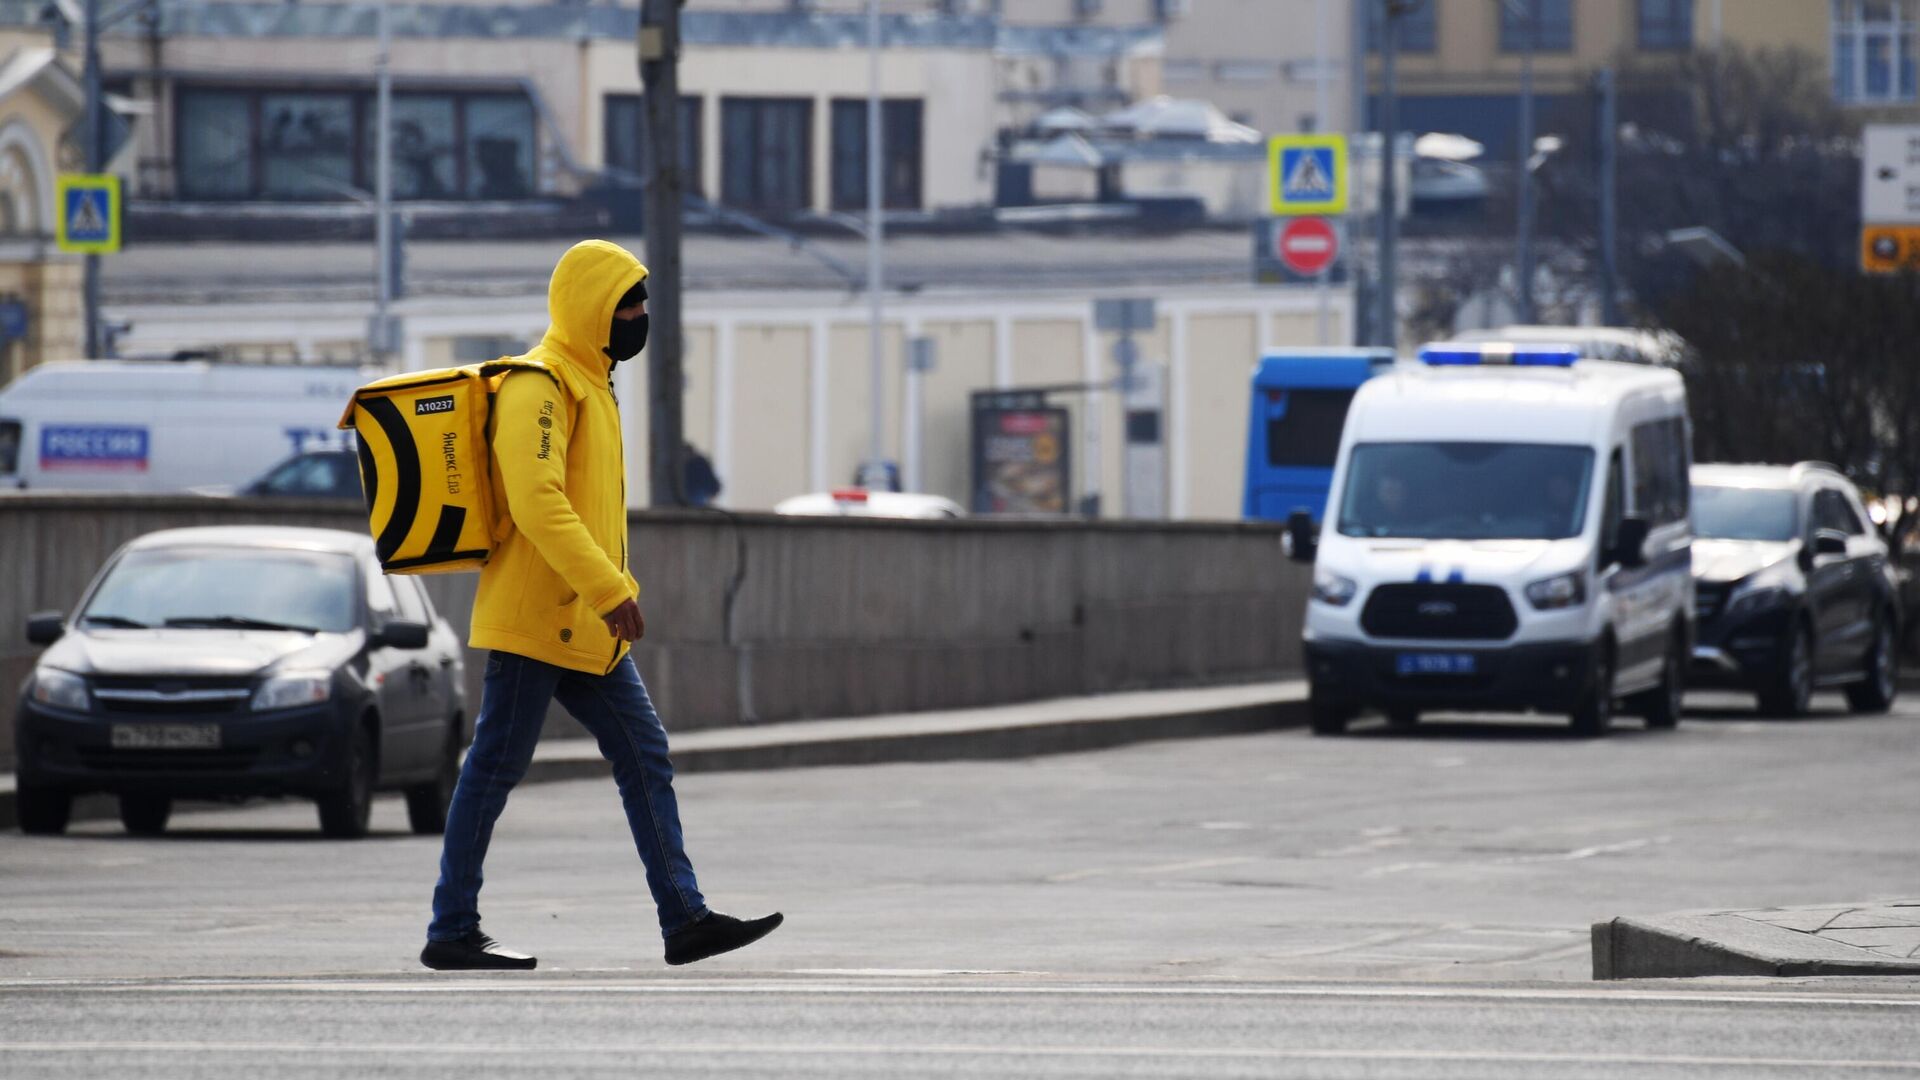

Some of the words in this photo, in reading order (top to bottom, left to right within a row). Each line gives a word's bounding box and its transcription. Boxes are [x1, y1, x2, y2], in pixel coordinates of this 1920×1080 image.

[416, 400, 453, 413] A10237
[540, 401, 553, 416] Еда
[442, 432, 457, 472] Яндекс
[537, 430, 551, 460] Яндекс
[447, 473, 462, 495] Еда
